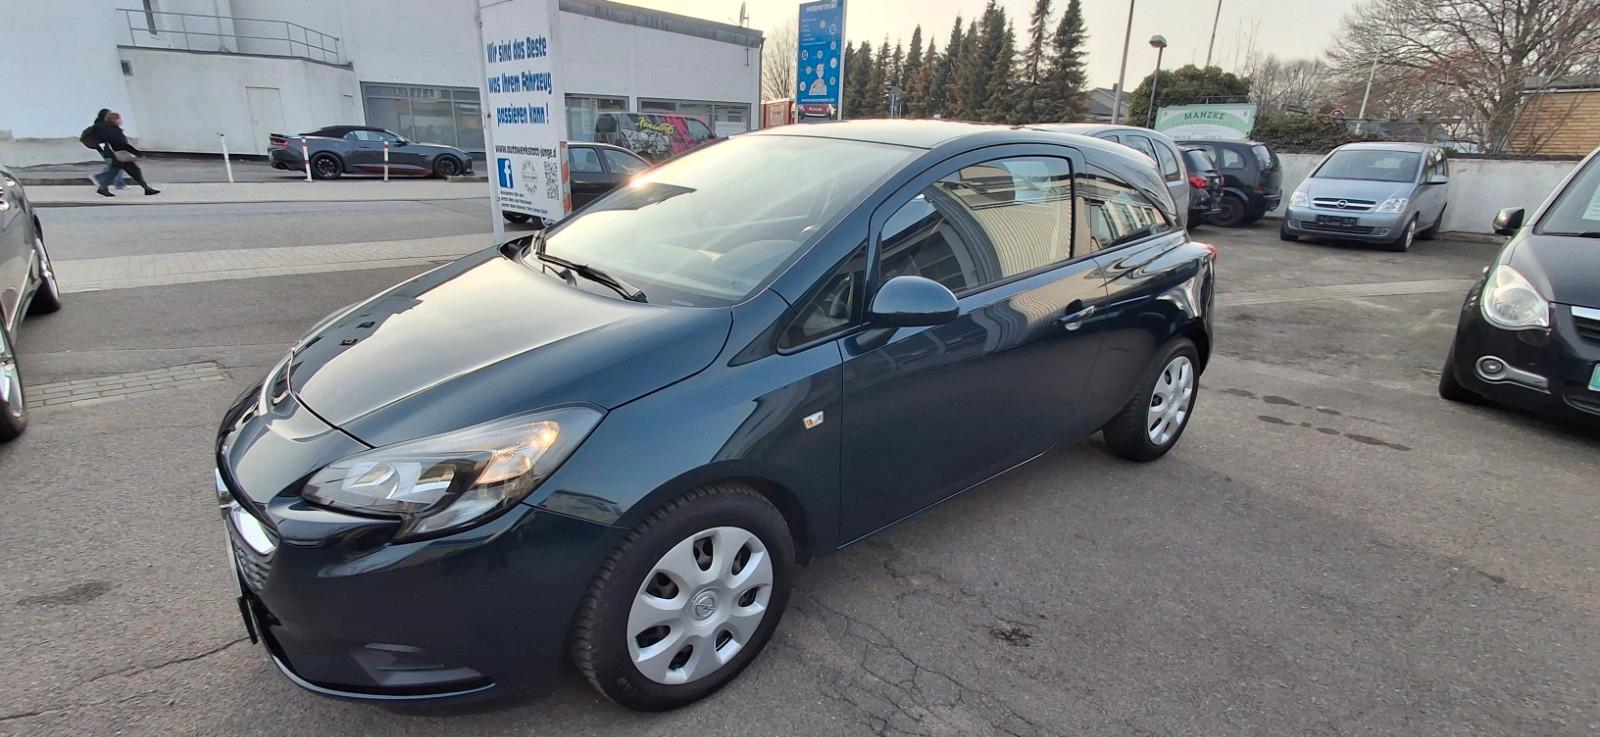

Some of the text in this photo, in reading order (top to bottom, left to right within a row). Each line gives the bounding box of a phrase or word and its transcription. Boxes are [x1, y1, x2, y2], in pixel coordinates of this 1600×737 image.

[487, 35, 547, 64] Wir sind das Beste
[488, 71, 552, 95] was Ihrem Fahrzeug
[496, 103, 528, 127] passieren
[528, 103, 545, 124] kann
[1184, 111, 1227, 121] MANZKE
